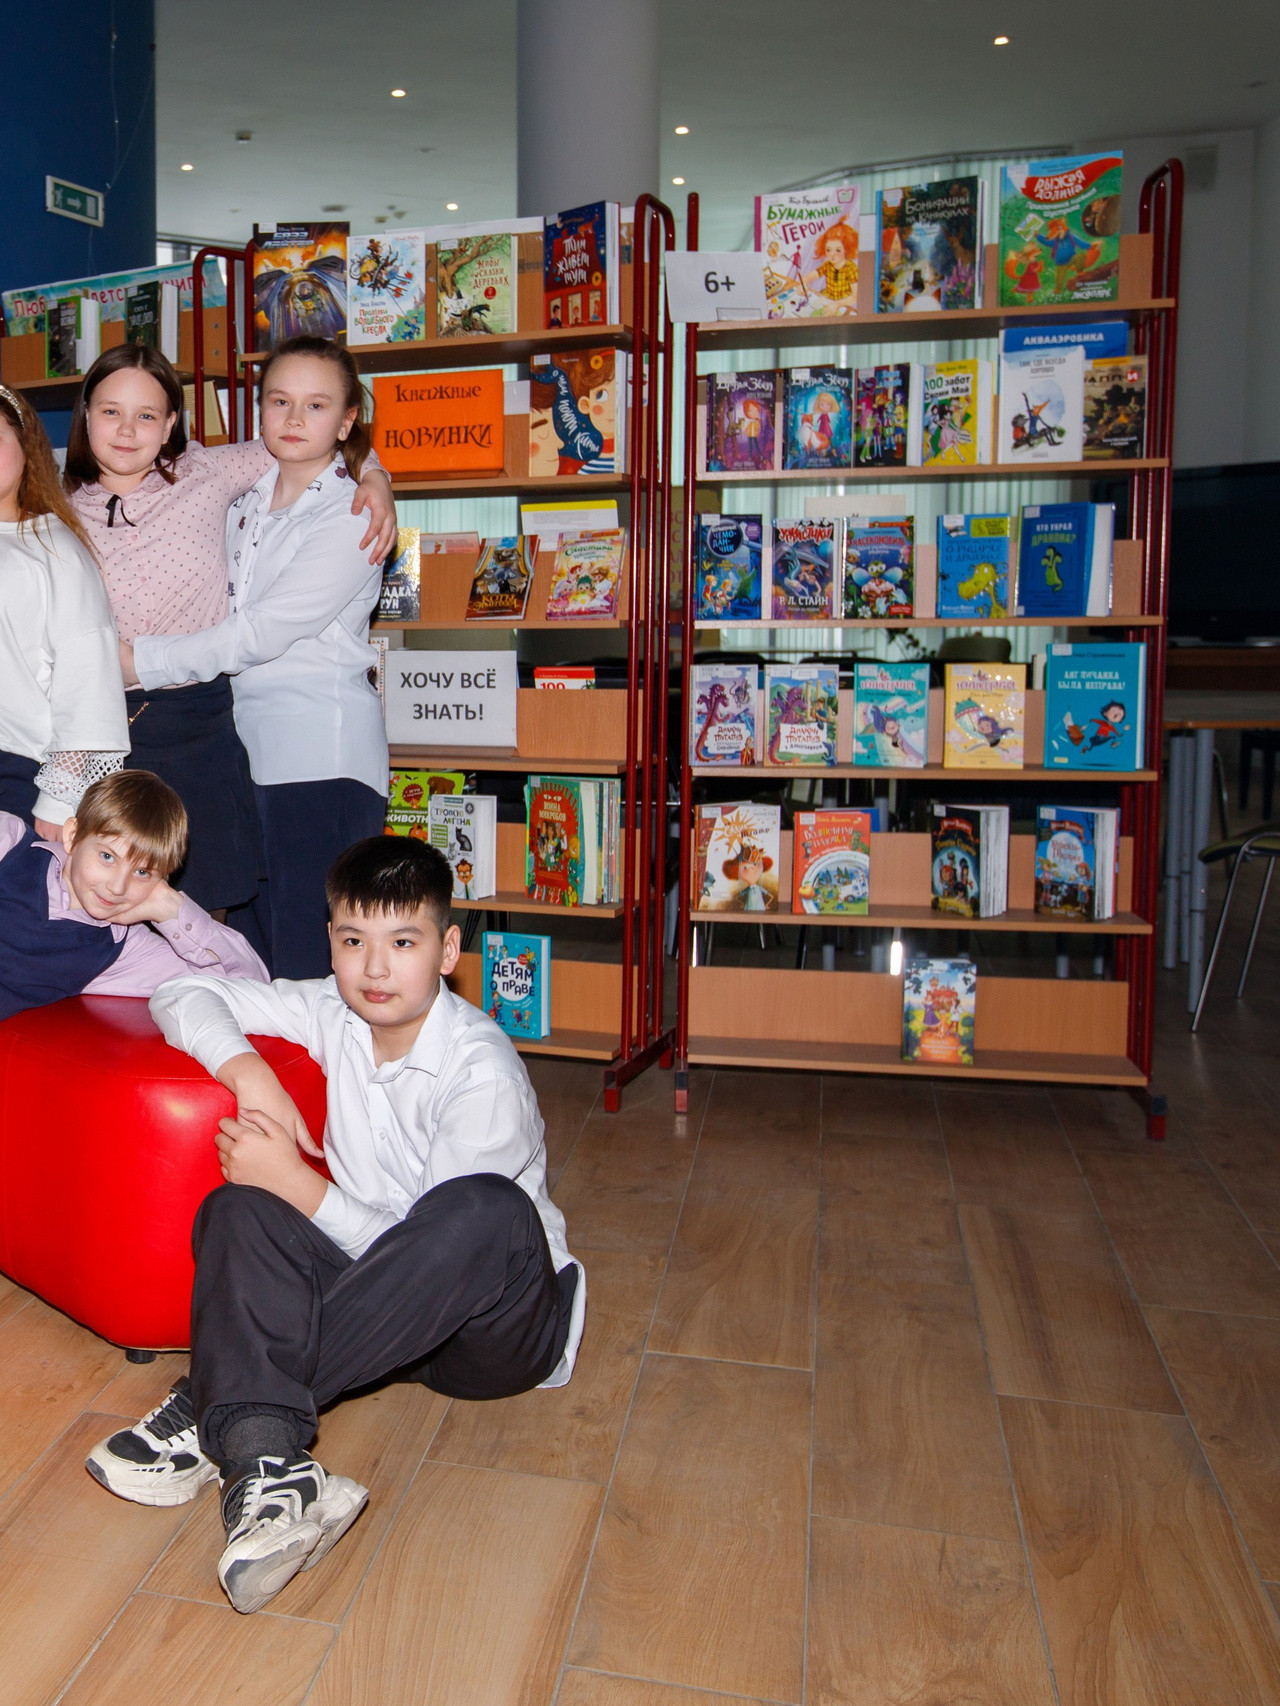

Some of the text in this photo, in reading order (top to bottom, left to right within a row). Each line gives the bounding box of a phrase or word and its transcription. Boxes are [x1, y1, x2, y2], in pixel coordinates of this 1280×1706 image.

[767, 204, 841, 220] БУМАЖНЫЕ
[782, 221, 825, 244] ГЕРОИ
[704, 271, 736, 294] 6+
[14, 296, 45, 318] Люб
[362, 325, 387, 336] КРЕСЛА
[925, 376, 971, 391] 100 забот
[395, 384, 482, 404] Книжные
[384, 424, 494, 450] НОВИНКИ
[798, 595, 829, 605] СТАЙН
[400, 669, 496, 689] ХОЧУ ВСЁ
[413, 703, 484, 721] ЗНАТЬ!
[387, 815, 428, 823] ЖИВОТН
[491, 961, 534, 982] ДЕТЯМ
[490, 980, 535, 997] О ПРАВЕ
